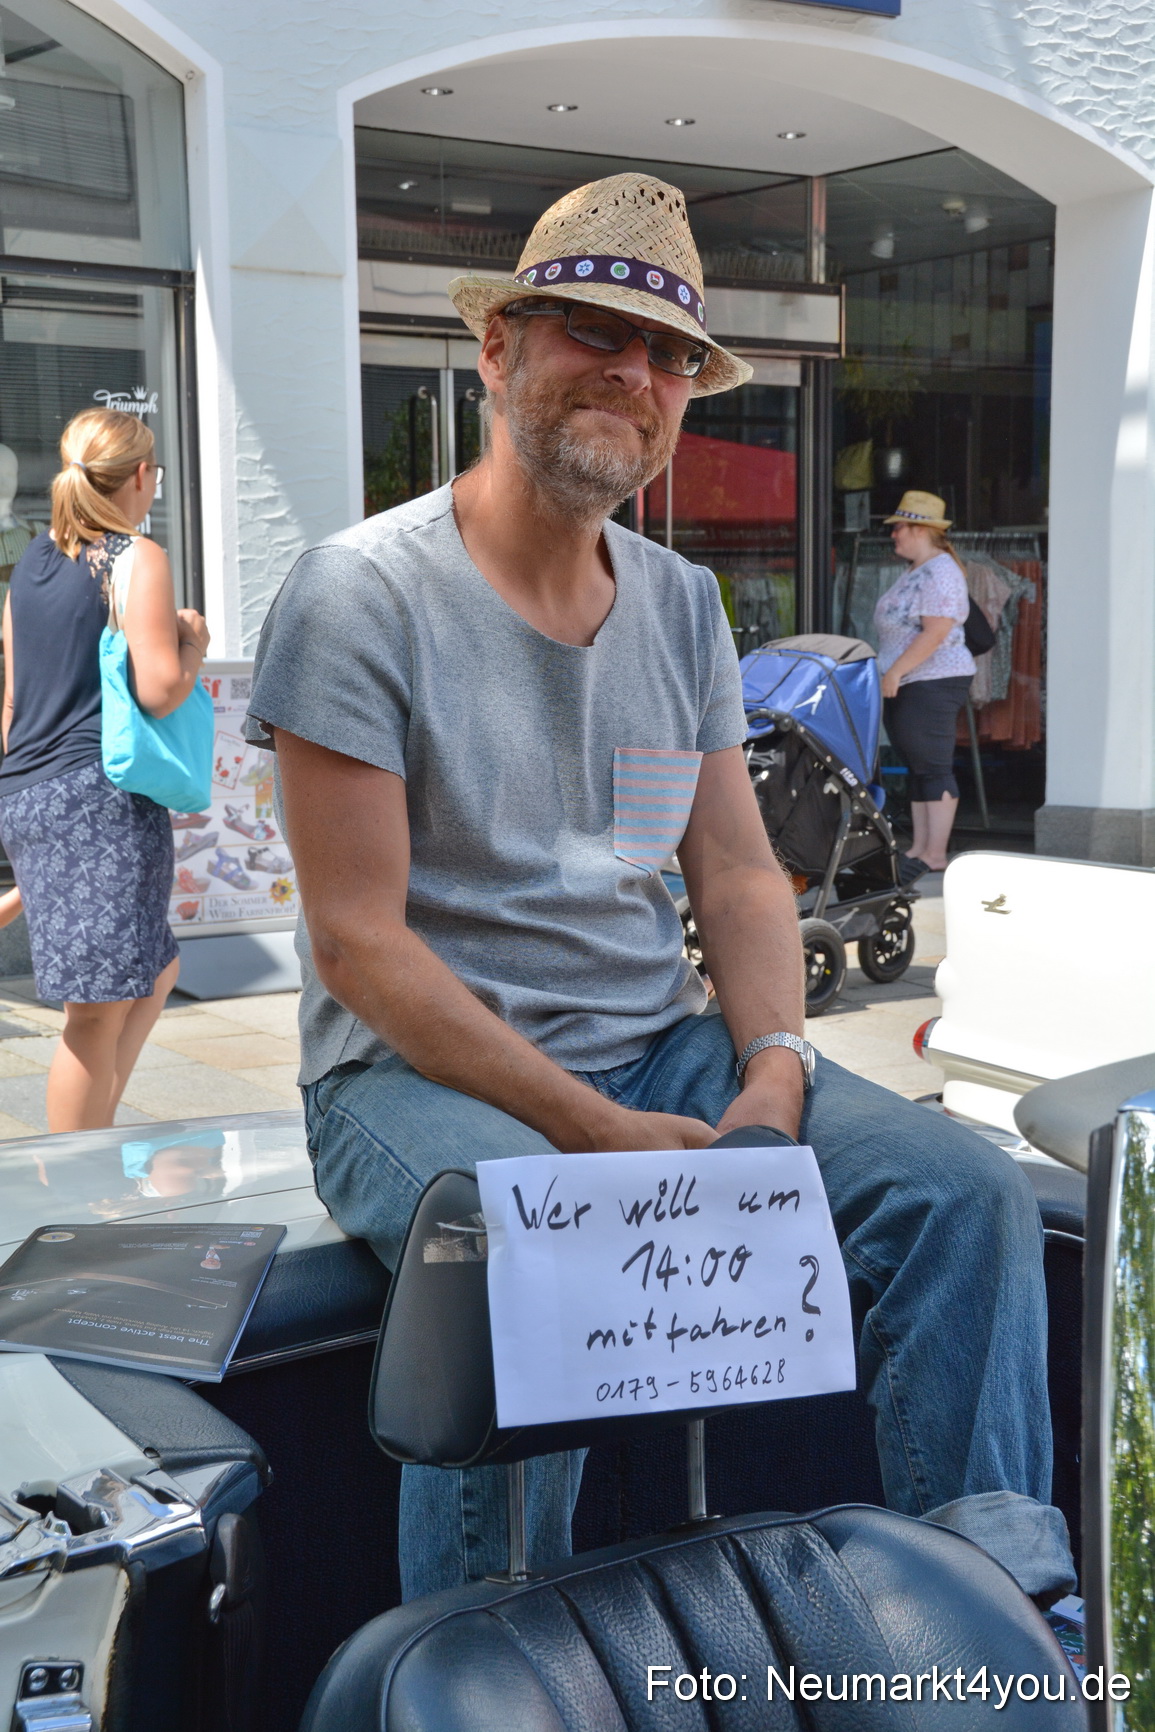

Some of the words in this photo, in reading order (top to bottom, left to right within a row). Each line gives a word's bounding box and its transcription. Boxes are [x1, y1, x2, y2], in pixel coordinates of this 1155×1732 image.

[92, 388, 158, 420] Triumph
[512, 1175, 591, 1230] Wer
[619, 1173, 699, 1228] will
[739, 1190, 800, 1213] um
[622, 1241, 752, 1292] 14:00
[68, 1318, 117, 1332] concept
[120, 1326, 156, 1336] active
[159, 1332, 185, 1342] best
[188, 1337, 210, 1346] The
